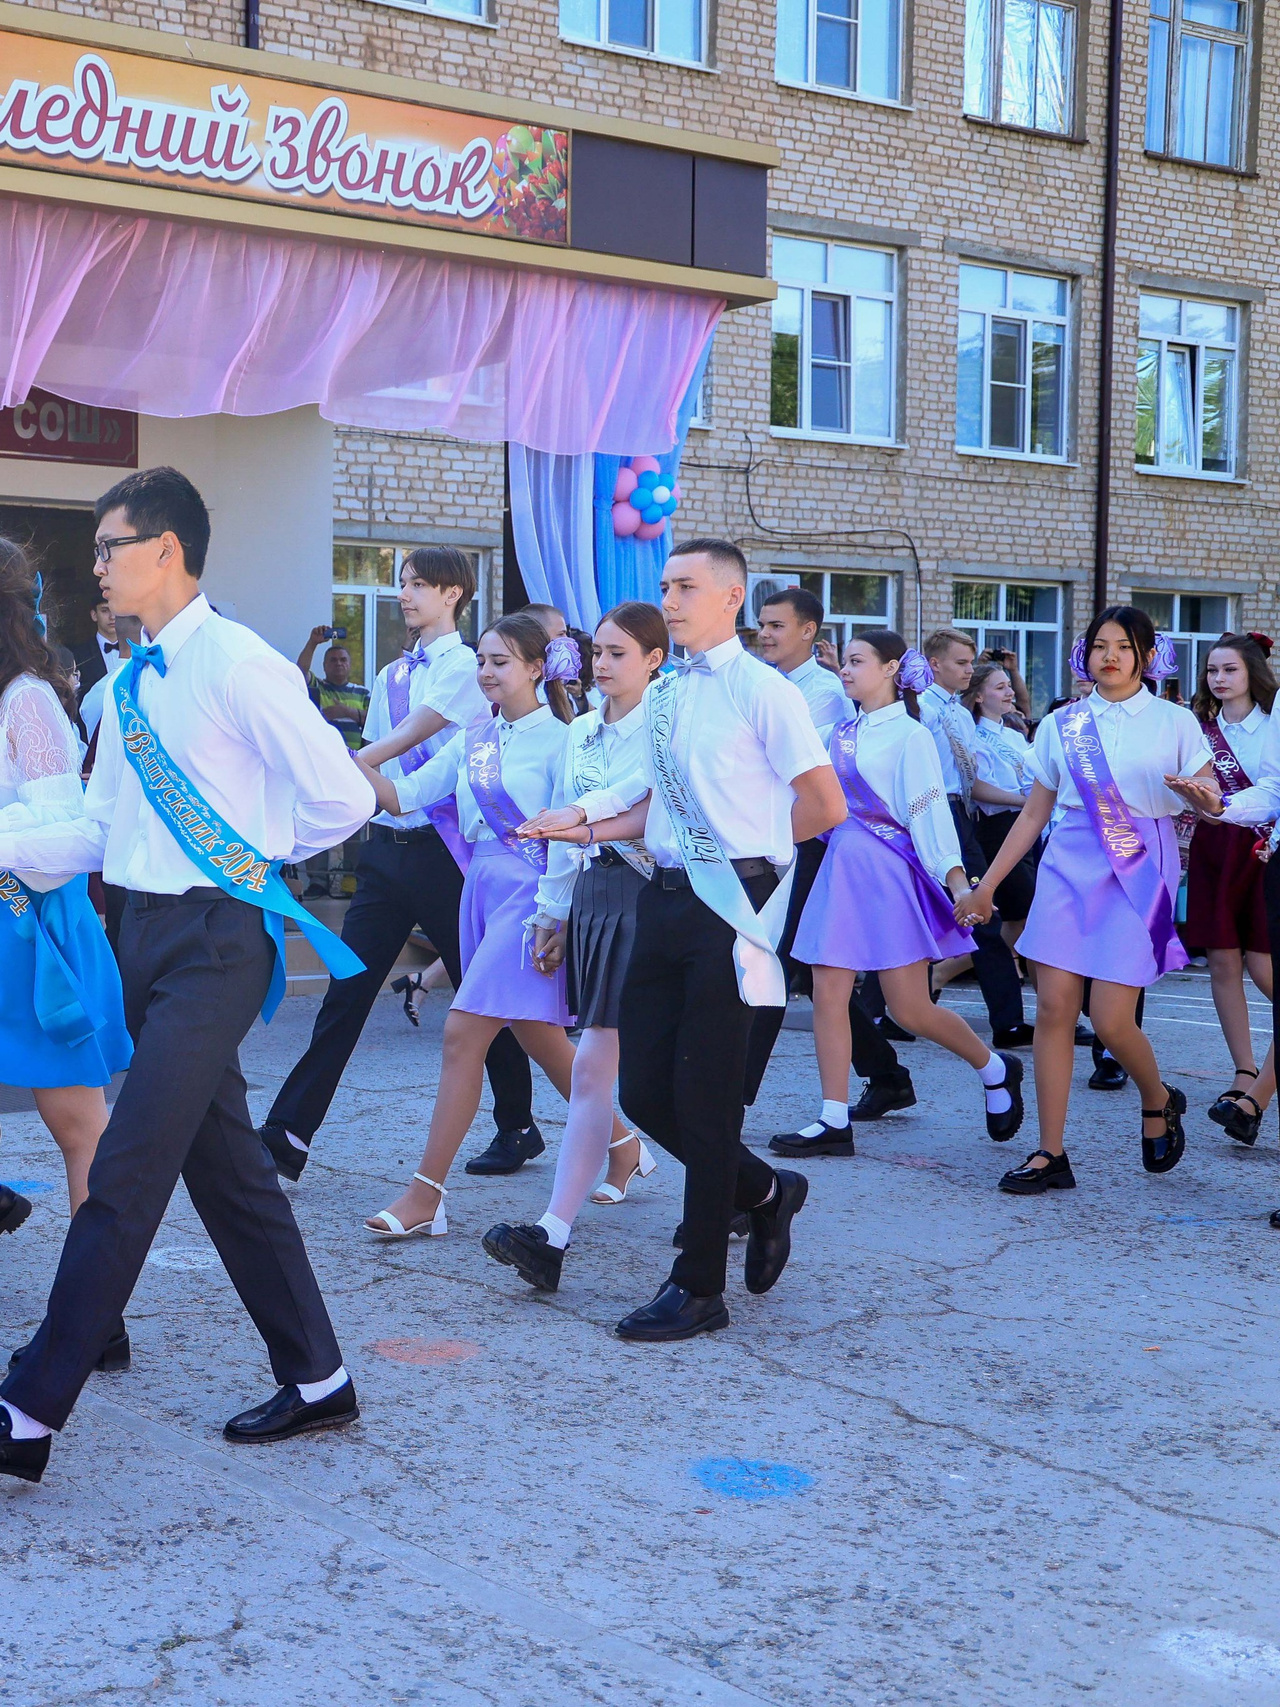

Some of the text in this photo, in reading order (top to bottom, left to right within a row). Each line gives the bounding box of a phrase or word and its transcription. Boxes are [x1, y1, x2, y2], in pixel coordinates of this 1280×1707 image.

[265, 95, 495, 218] звонок
[13, 405, 120, 445] СОШ»
[122, 708, 225, 853] Выпускник
[653, 712, 691, 821] Выпускник
[687, 826, 723, 865] 2024
[1073, 735, 1116, 825] Выпускница
[1102, 823, 1147, 858] 2024
